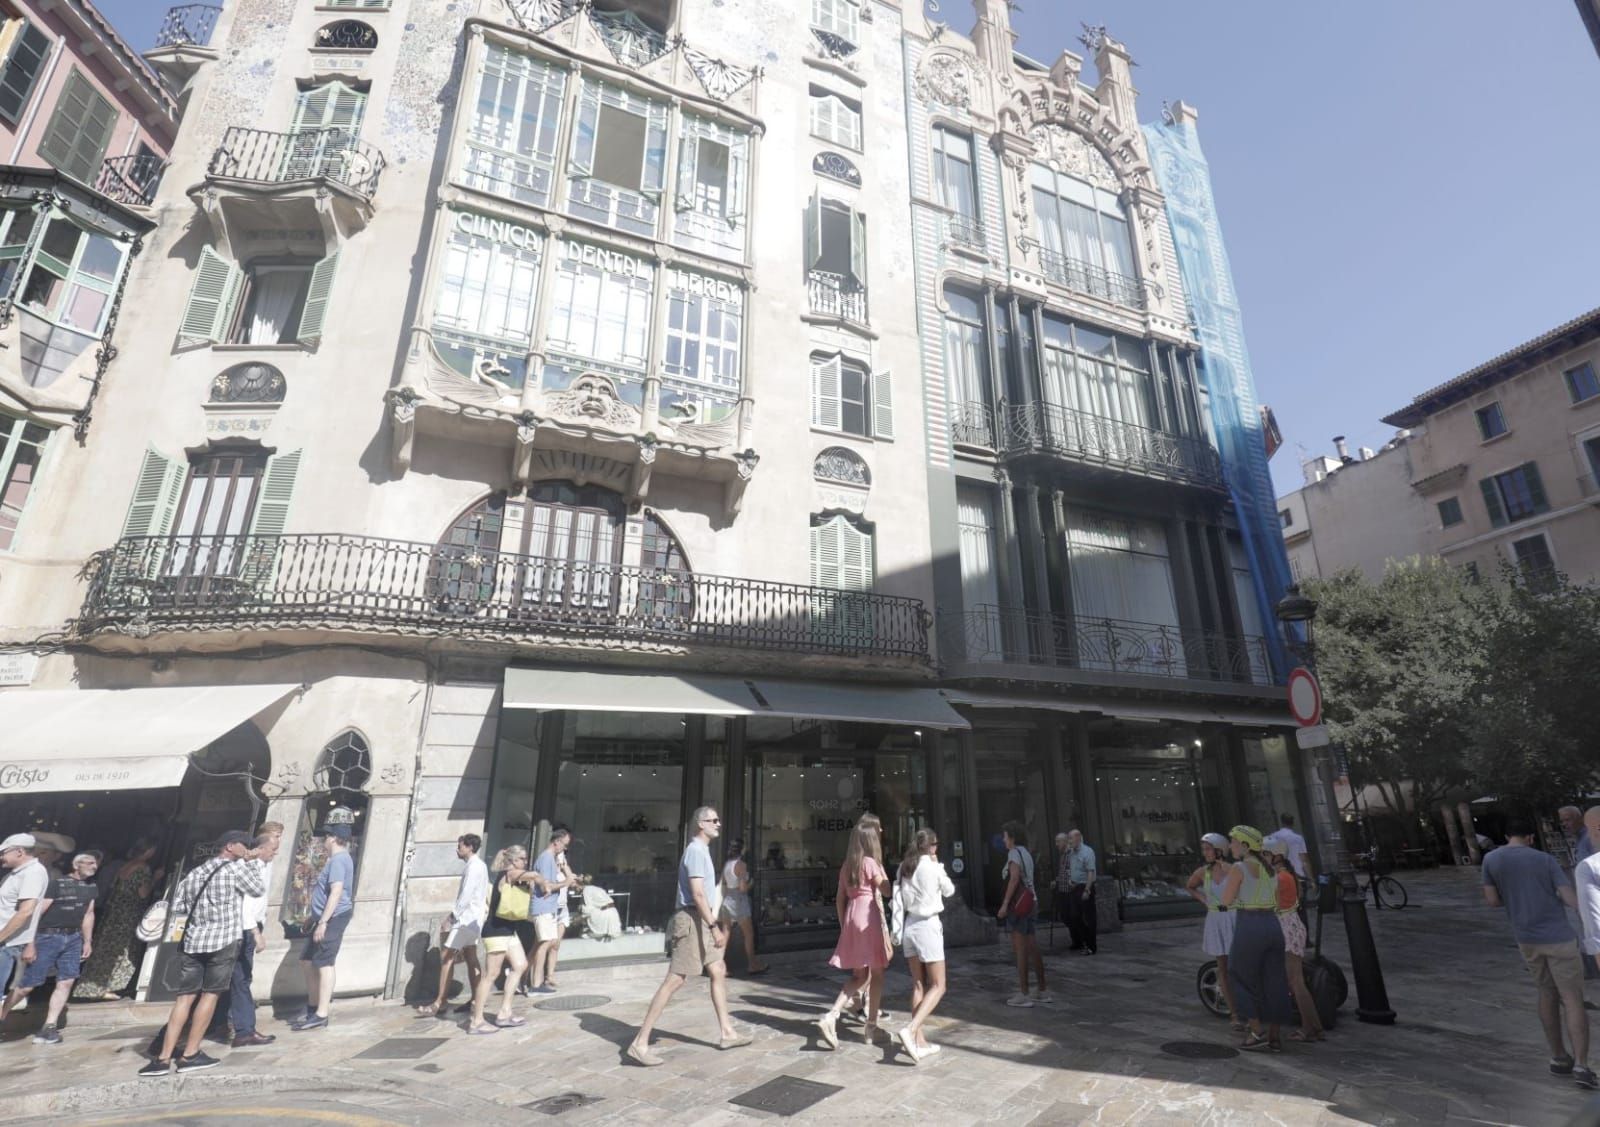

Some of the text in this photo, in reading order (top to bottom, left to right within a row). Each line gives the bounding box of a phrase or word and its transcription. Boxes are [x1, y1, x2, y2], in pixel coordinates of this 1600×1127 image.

[457, 211, 538, 252] CLINICA
[567, 240, 649, 281] DENTAL
[0, 763, 50, 789] Cristo
[106, 771, 130, 780] 1910
[817, 818, 855, 832] REBA
